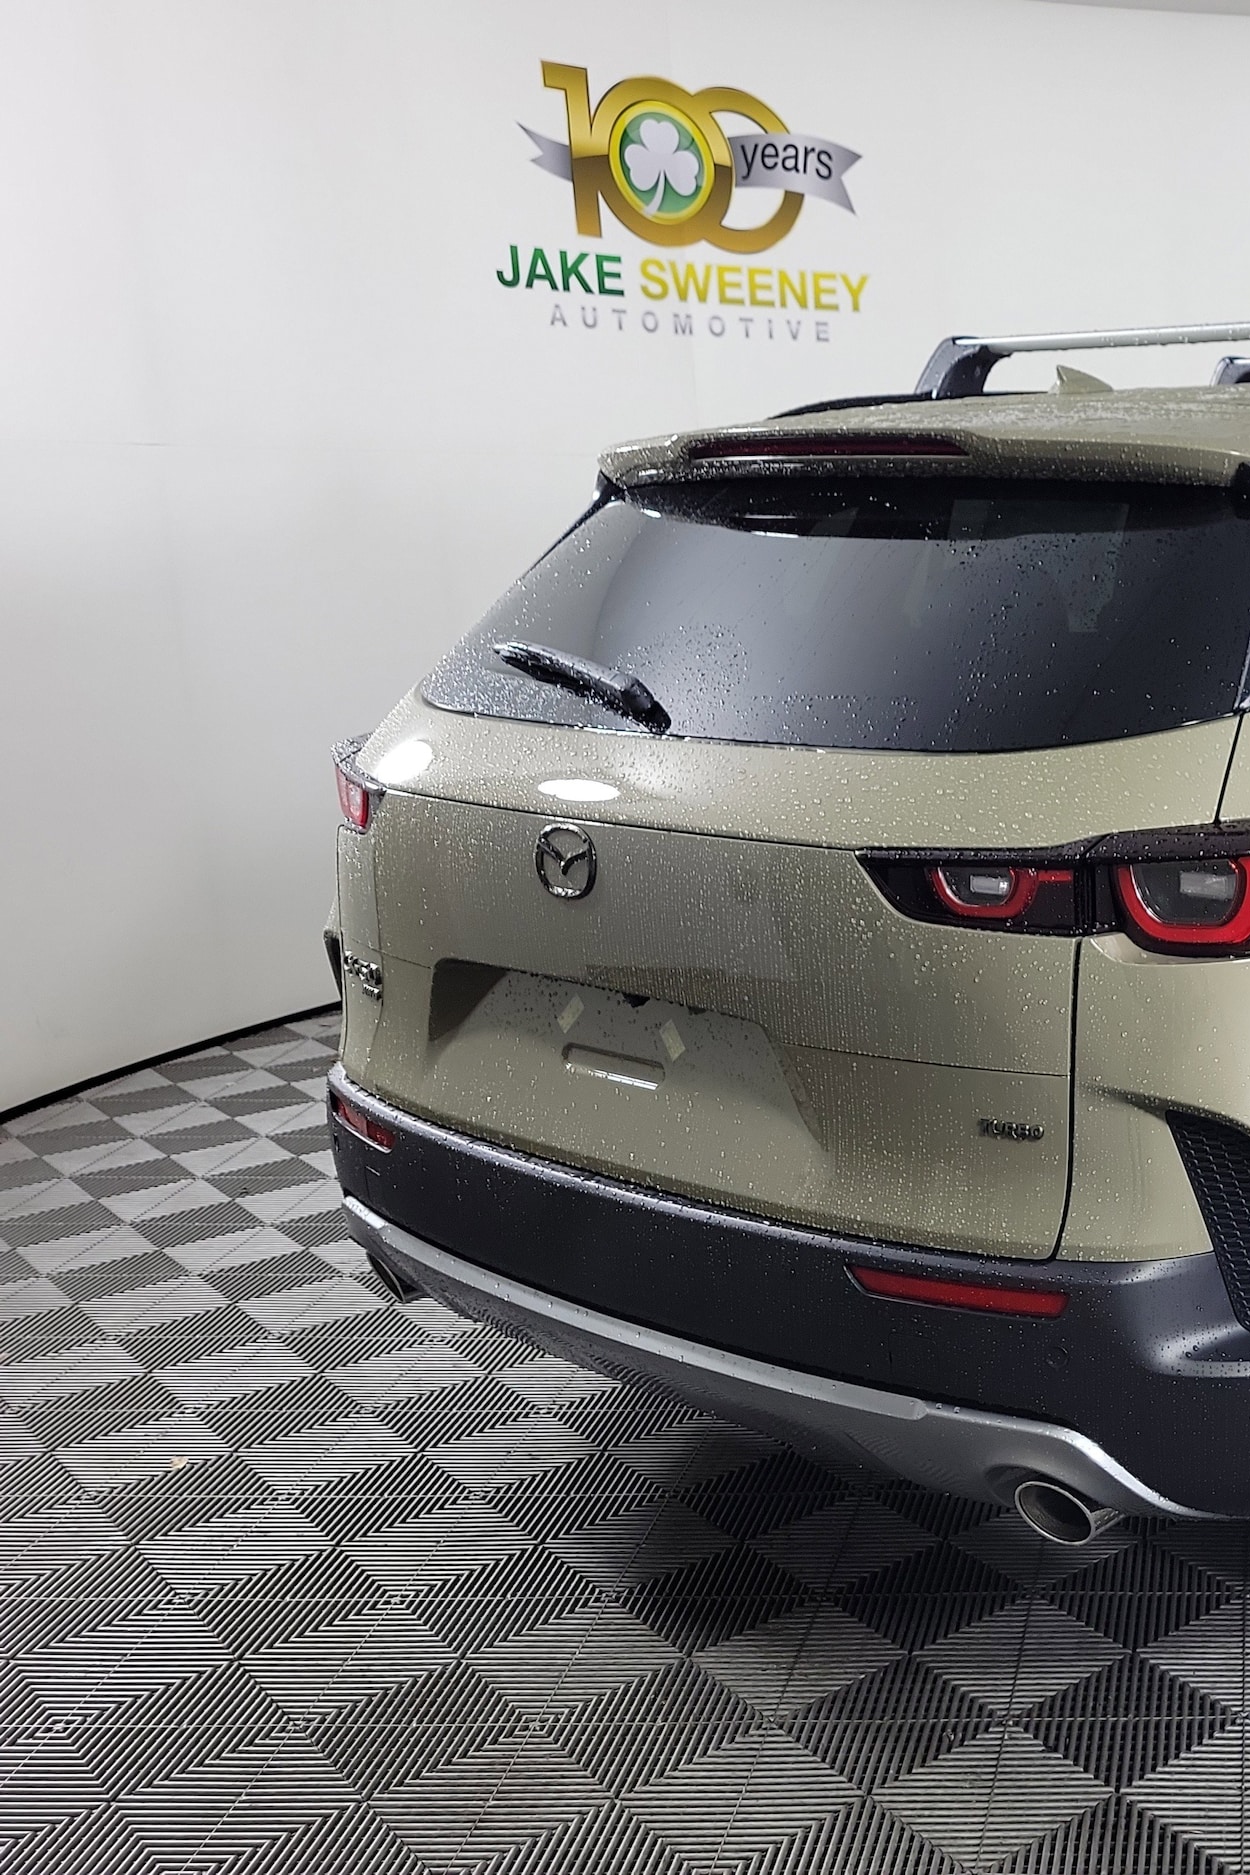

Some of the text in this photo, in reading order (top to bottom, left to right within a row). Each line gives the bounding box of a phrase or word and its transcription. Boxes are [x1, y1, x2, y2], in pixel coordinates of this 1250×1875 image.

[541, 60, 834, 254] 100 years
[496, 245, 870, 313] JAKE SWEENEY
[549, 303, 831, 343] AUTOMOTIVE
[978, 1118, 1045, 1141] TURBO
